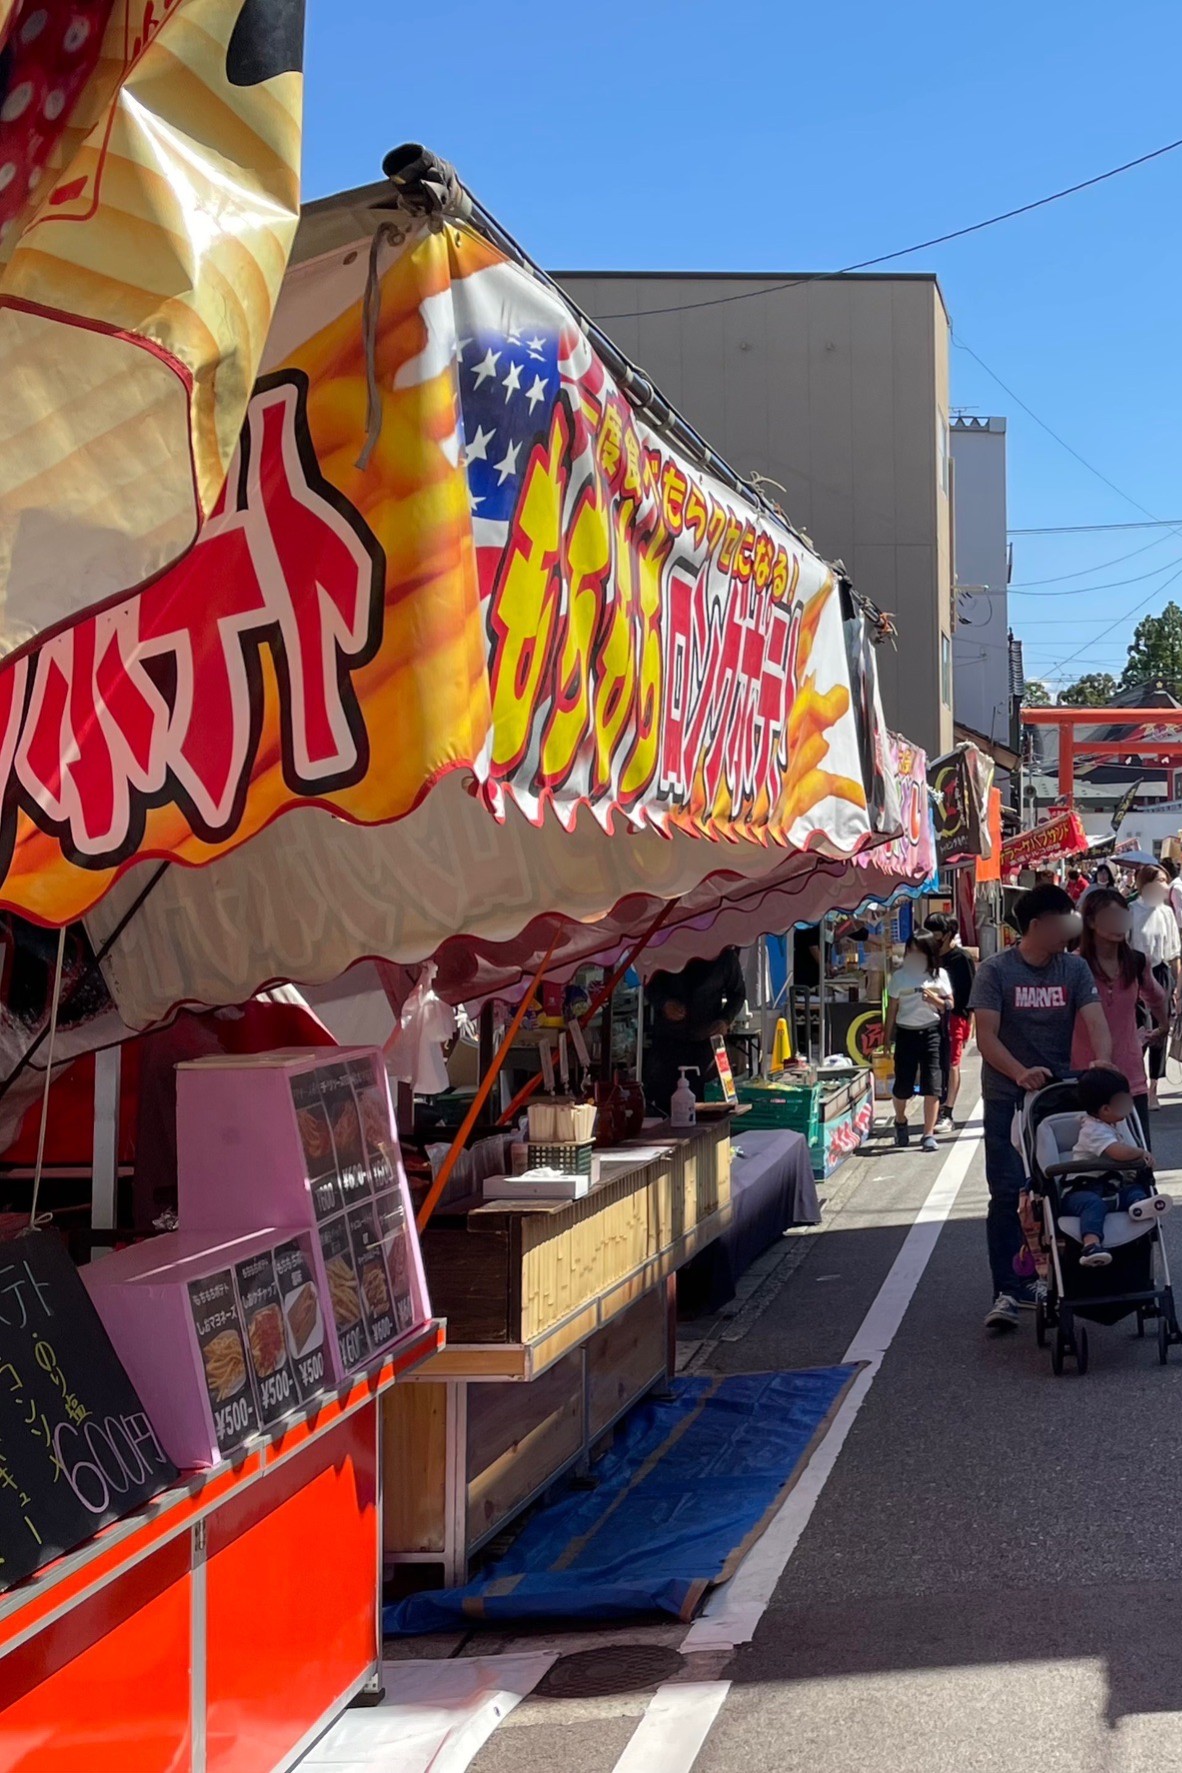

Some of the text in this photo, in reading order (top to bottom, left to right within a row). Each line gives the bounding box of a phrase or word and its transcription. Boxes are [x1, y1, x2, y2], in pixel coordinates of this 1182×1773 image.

[1015, 986, 1066, 1007] MARVEL
[196, 1304, 238, 1336] しおマヨネーズ
[215, 1398, 254, 1441] ¥500-
[52, 1411, 167, 1513] 600円
